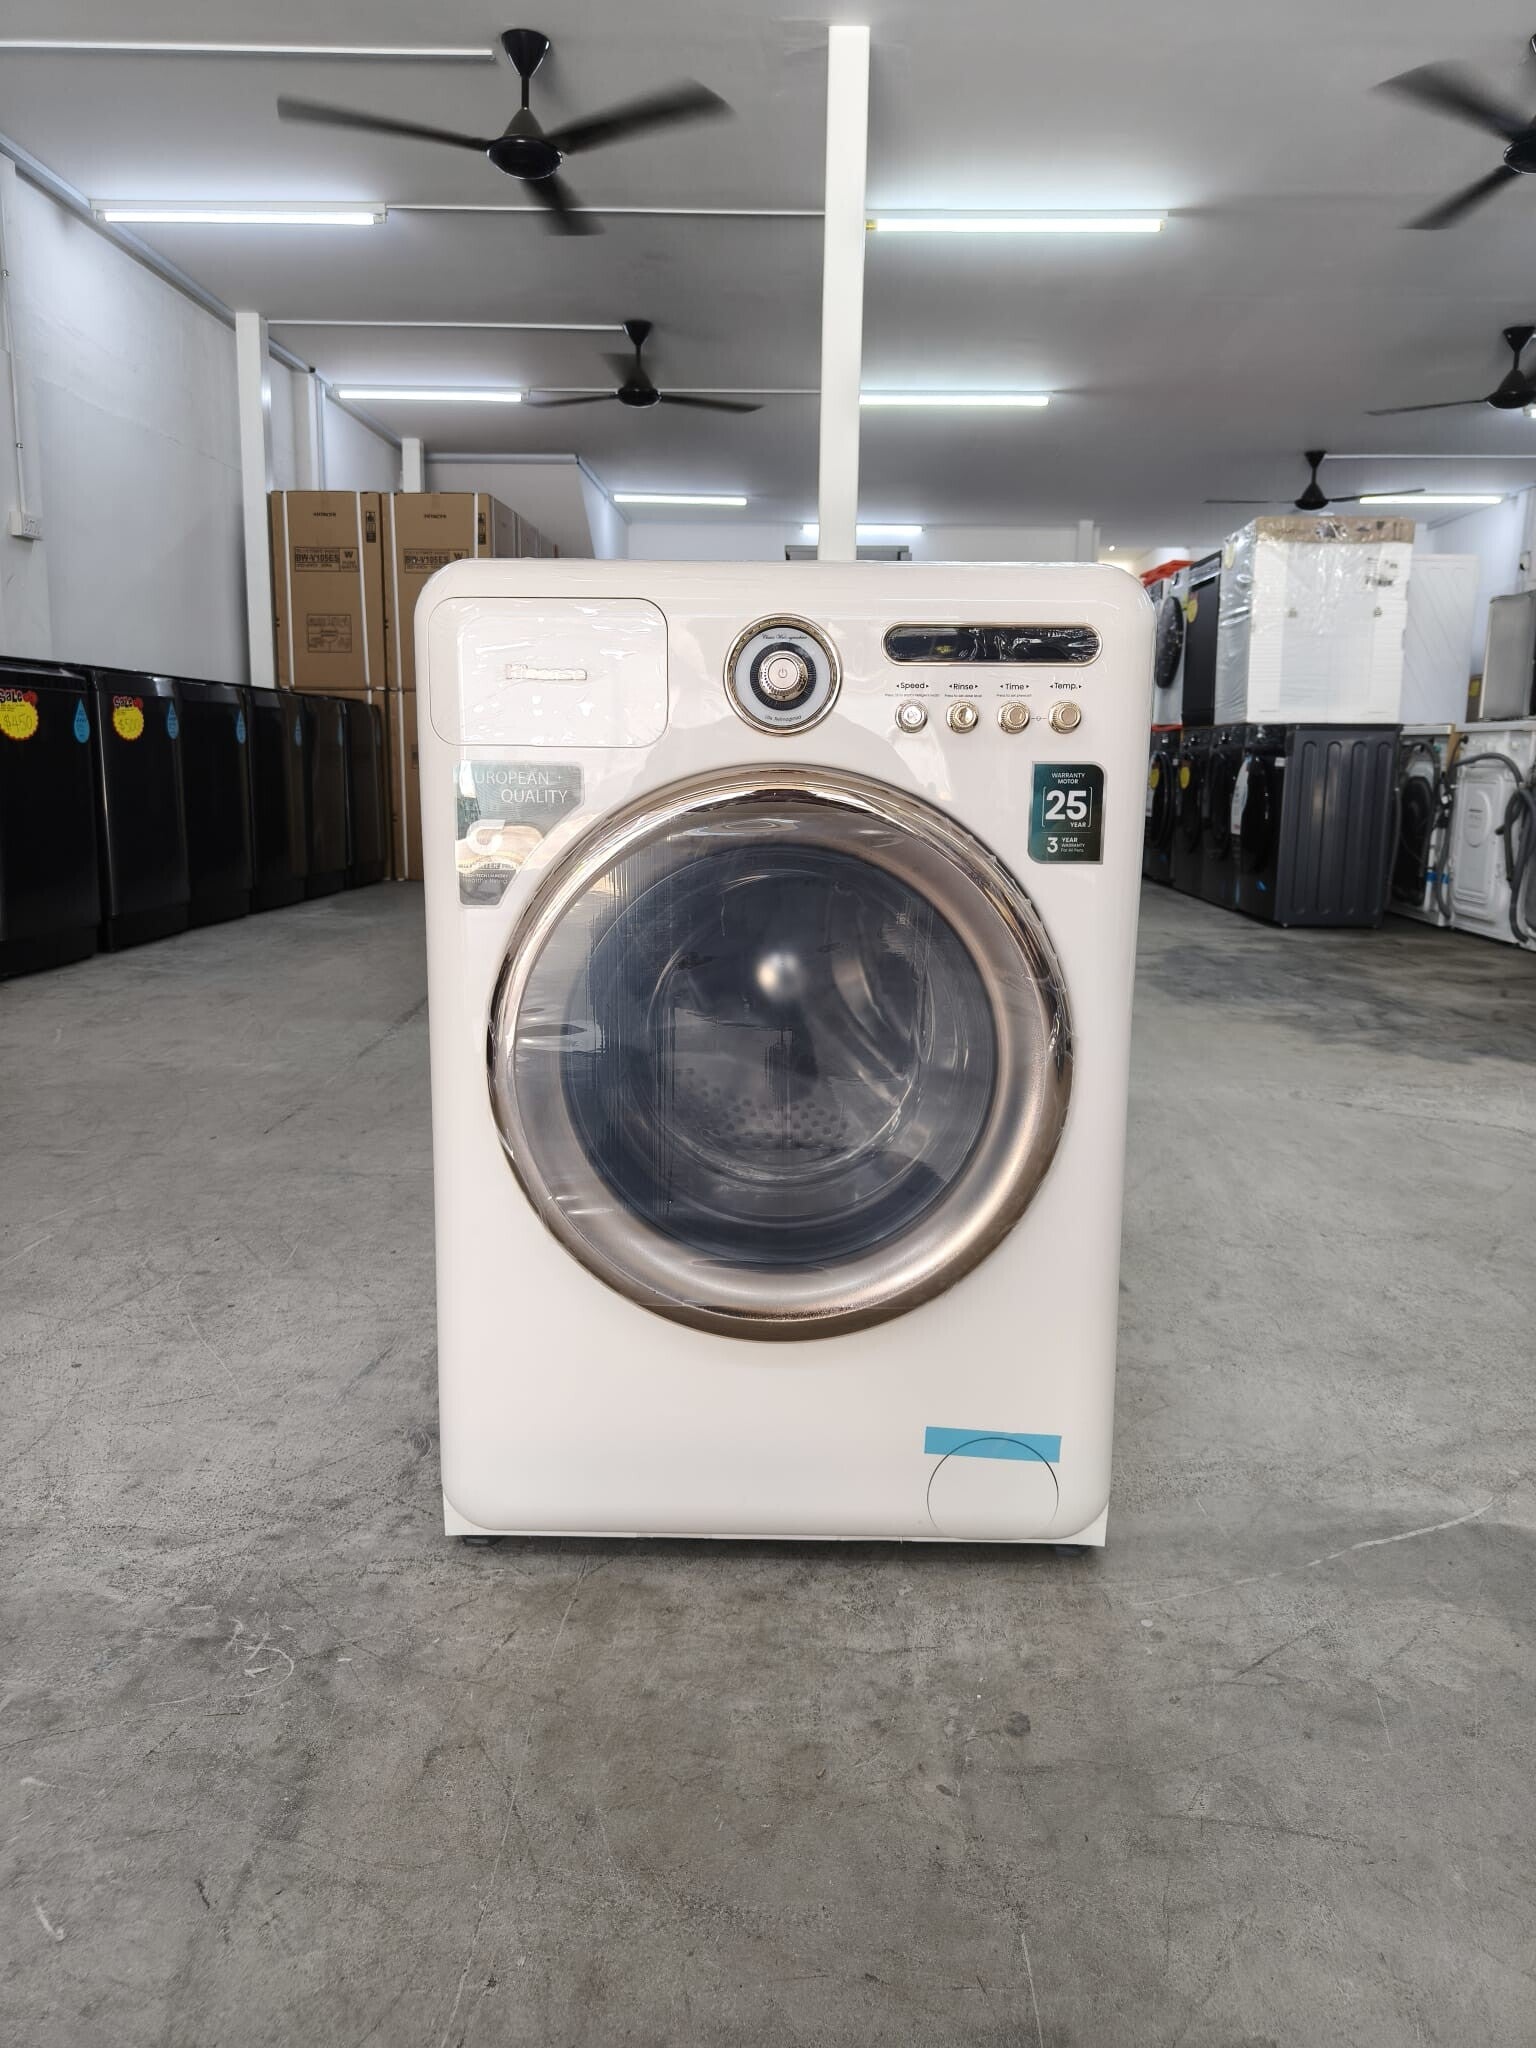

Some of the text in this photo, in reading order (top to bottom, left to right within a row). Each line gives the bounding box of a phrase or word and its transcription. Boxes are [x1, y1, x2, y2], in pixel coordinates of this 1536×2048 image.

[901, 682, 925, 691] Speed
[1055, 682, 1078, 690] Temp.
[474, 771, 549, 785] UROPEAN
[501, 789, 568, 803] QUALITY
[1045, 790, 1087, 820] 25
[1047, 837, 1059, 853] 3
